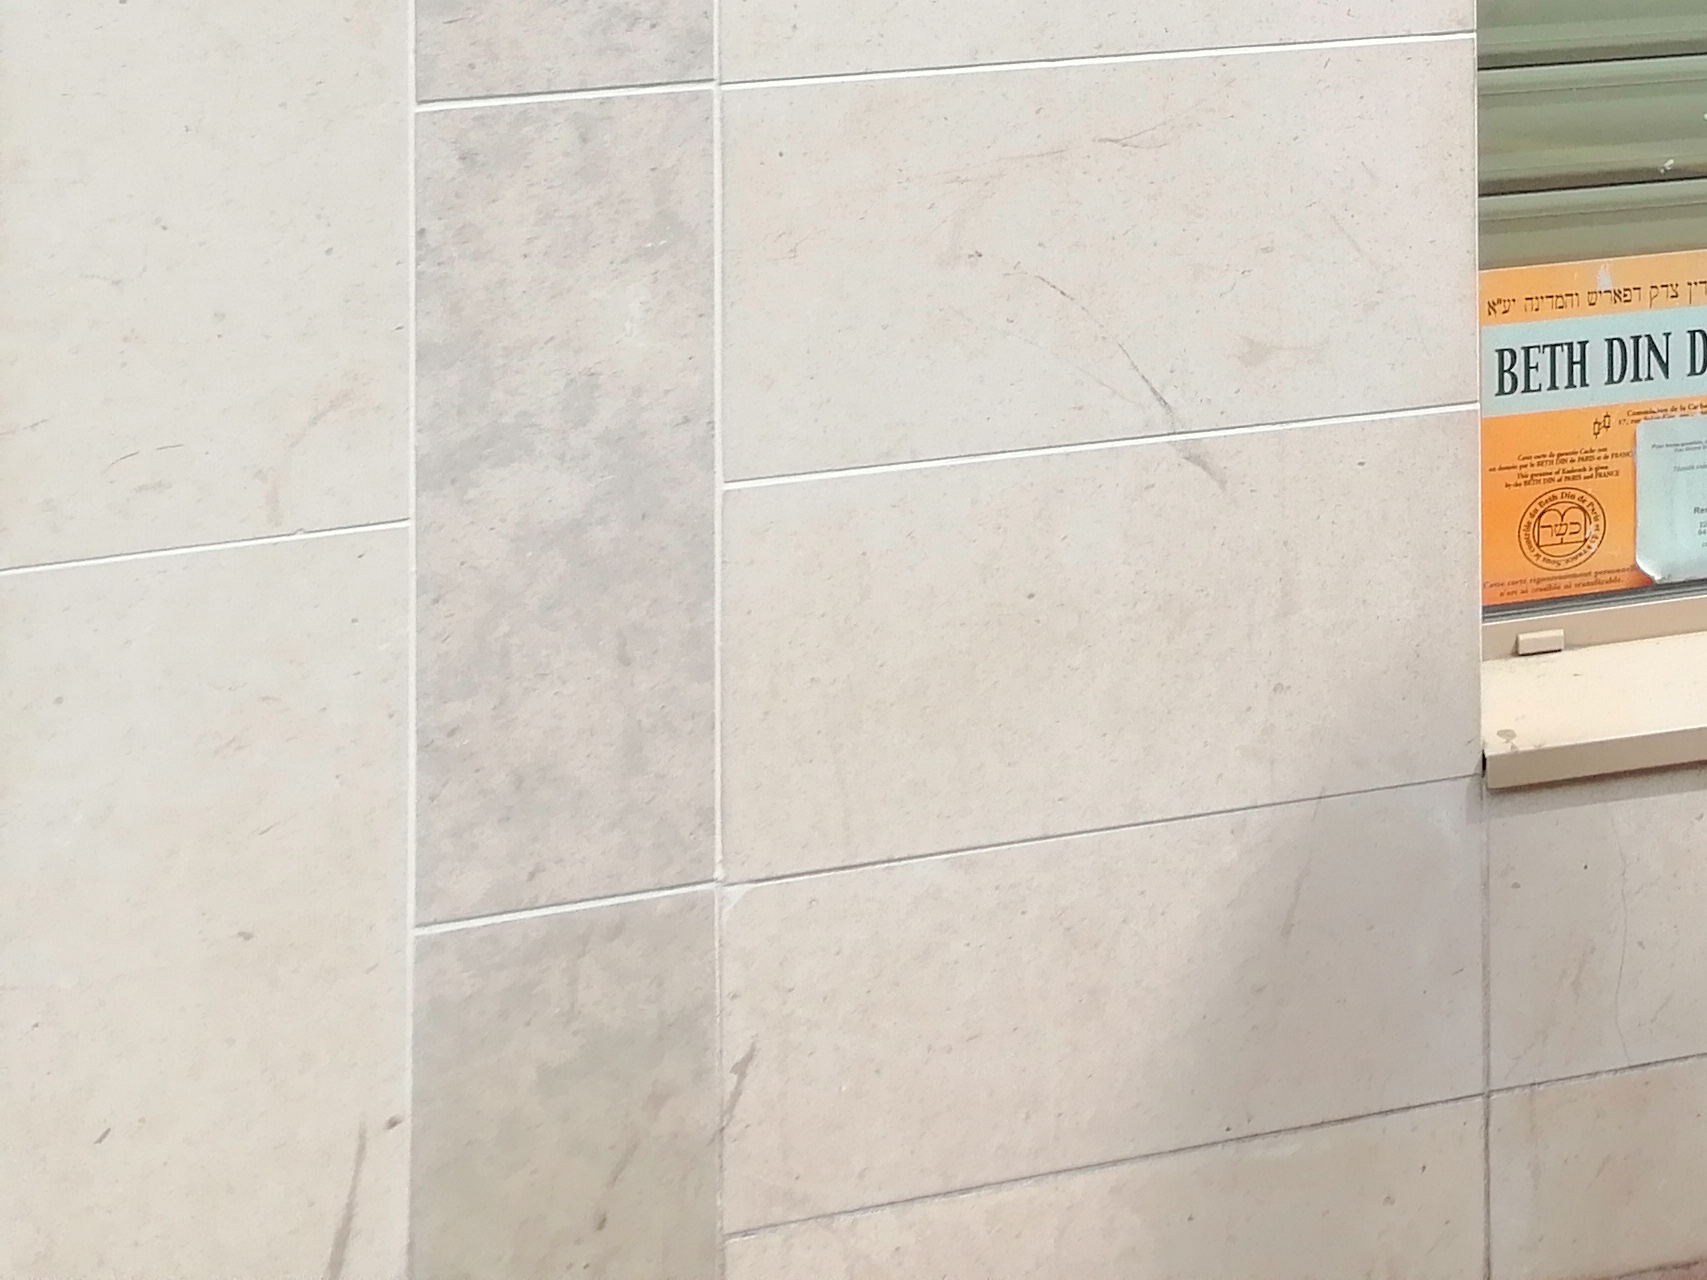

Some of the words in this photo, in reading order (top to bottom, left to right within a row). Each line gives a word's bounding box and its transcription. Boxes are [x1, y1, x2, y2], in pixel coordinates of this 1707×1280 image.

[1650, 283, 1679, 308] צדק
[1687, 281, 1707, 304] דין
[1495, 340, 1589, 397] BETH
[1604, 332, 1672, 385] DIN
[1536, 458, 1553, 467] BETH
[1555, 457, 1568, 465] DIN
[1577, 454, 1595, 463] PARIS
[1523, 478, 1540, 487] BETH
[1542, 476, 1555, 484] DIN
[1564, 473, 1581, 482] PARIS
[1538, 494, 1558, 507] Beth
[1561, 491, 1576, 499] Din
[1578, 495, 1587, 503] de
[1540, 522, 1581, 537] כשר
